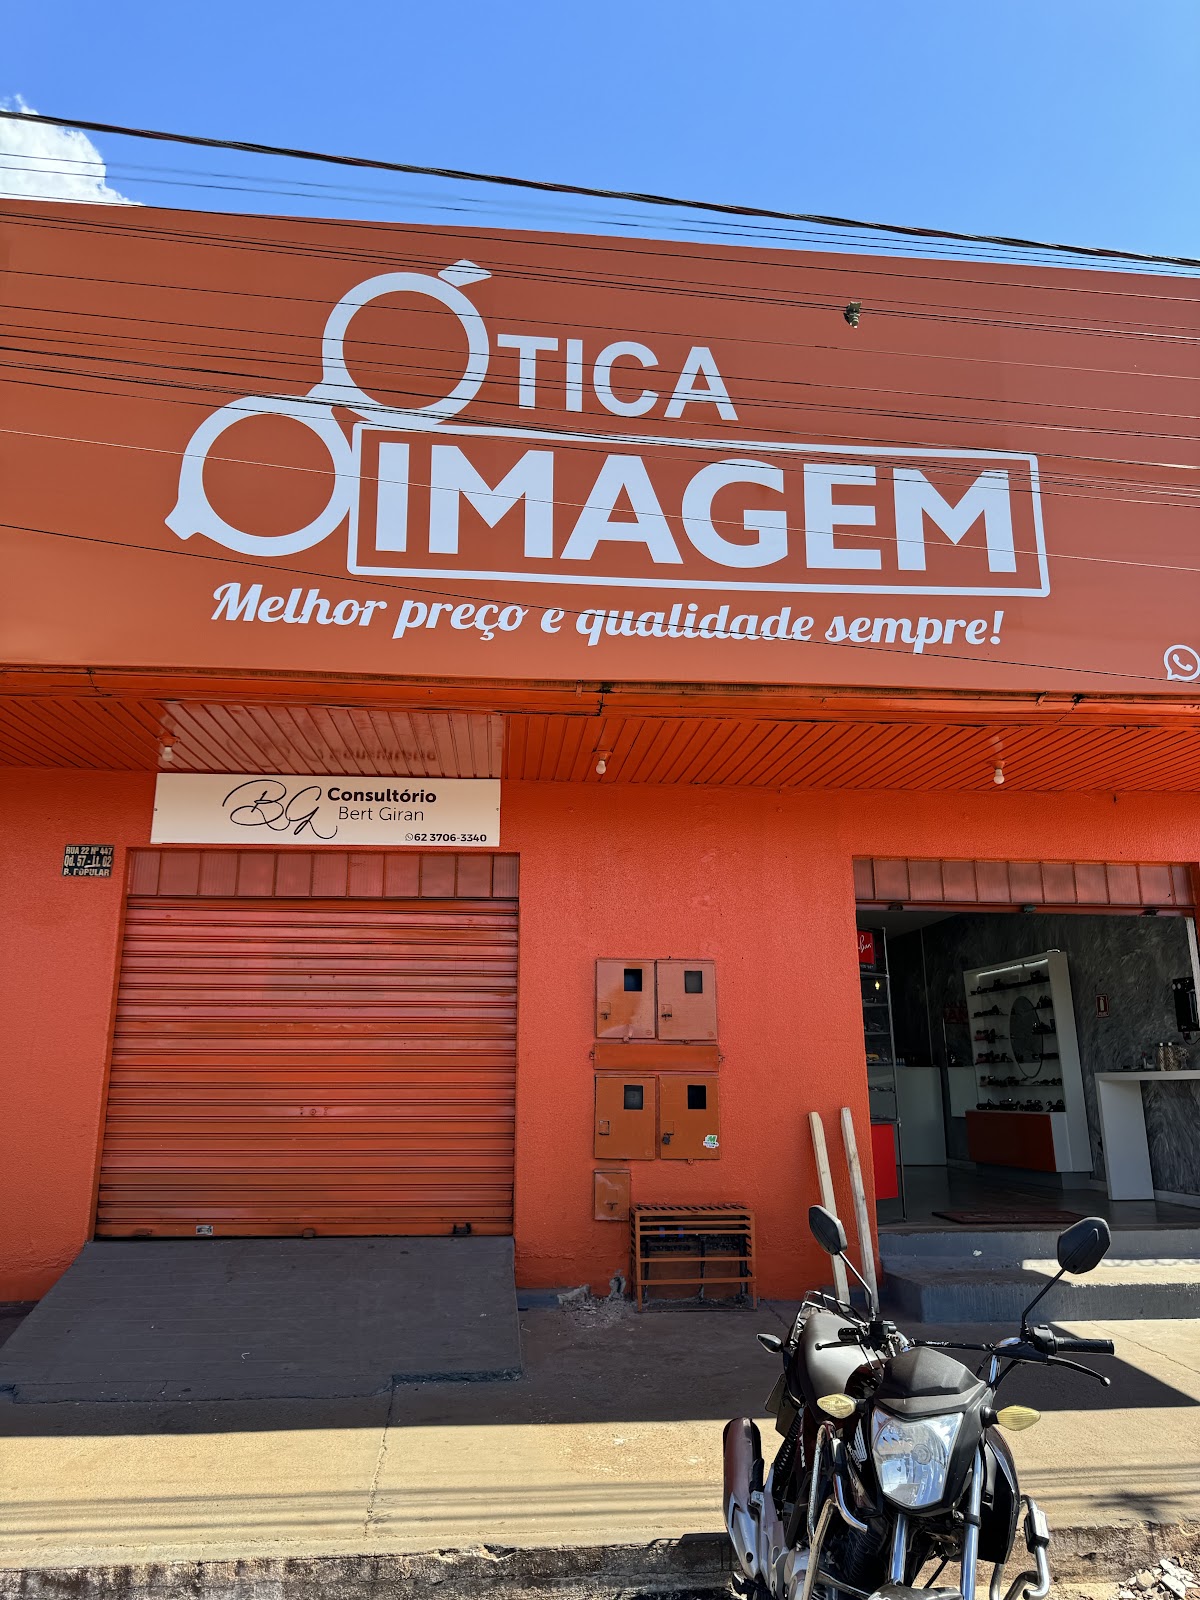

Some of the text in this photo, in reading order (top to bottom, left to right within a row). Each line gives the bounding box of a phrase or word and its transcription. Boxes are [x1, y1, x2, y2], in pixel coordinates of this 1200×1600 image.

[375, 441, 1017, 573] IMAGEM
[210, 582, 1004, 655] Melhor preço e qualidade sempre!
[327, 787, 437, 803] Consultório
[338, 806, 424, 821] Bert Giran
[413, 833, 487, 842] 62 3706-3340
[100, 847, 113, 855] 447
[64, 855, 75, 867] Qd.
[77, 855, 86, 867] 57
[102, 856, 112, 867] 02
